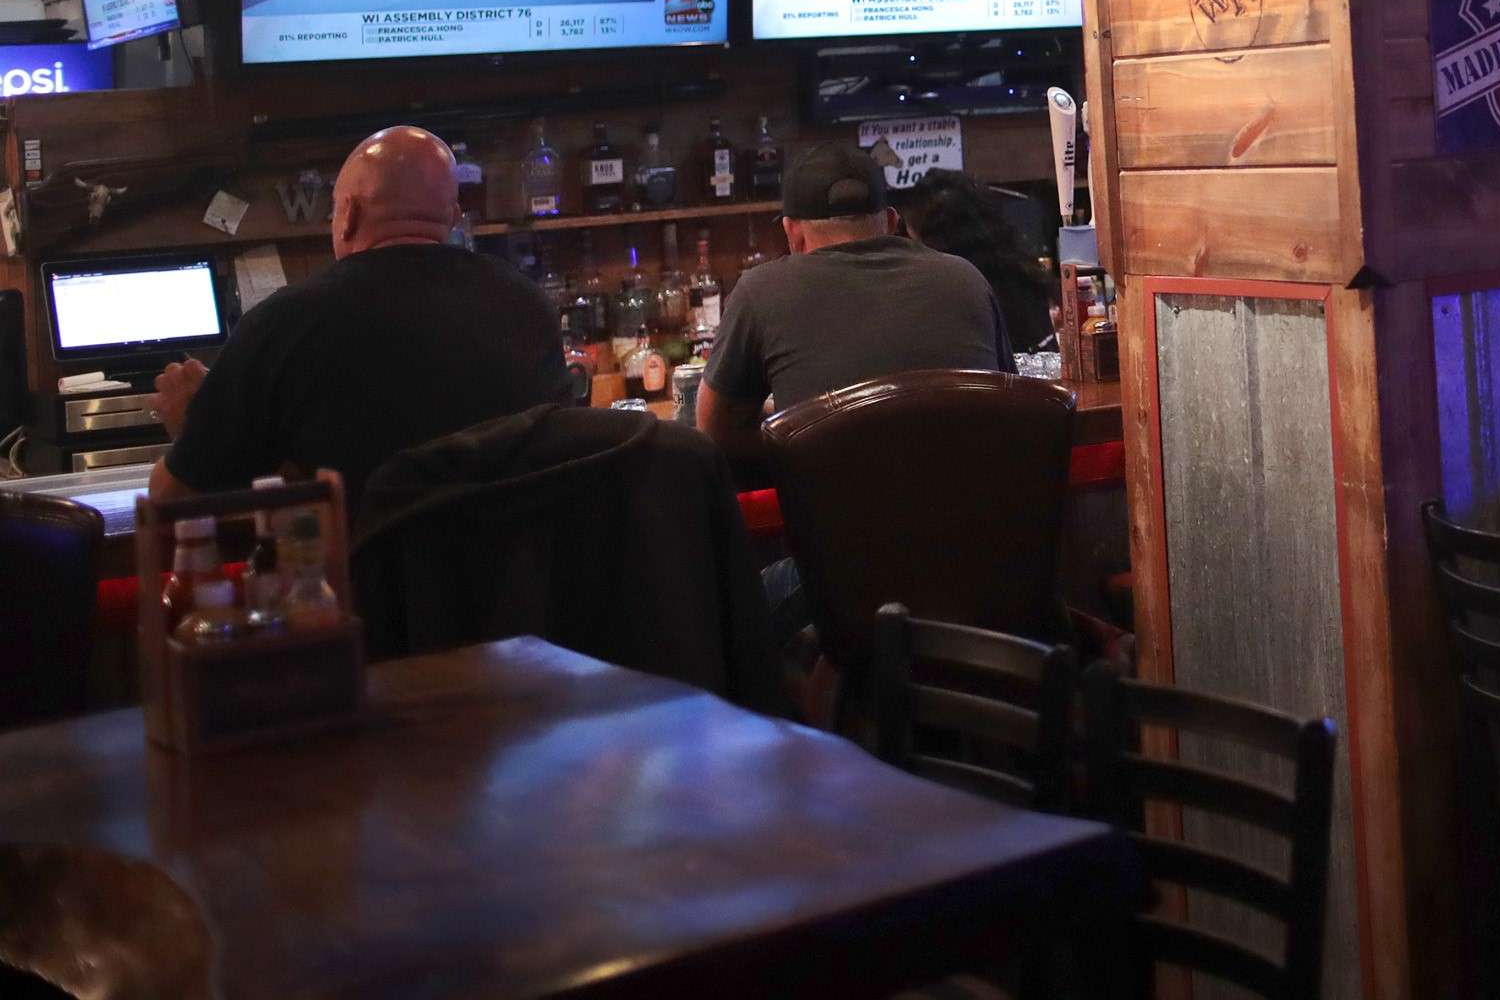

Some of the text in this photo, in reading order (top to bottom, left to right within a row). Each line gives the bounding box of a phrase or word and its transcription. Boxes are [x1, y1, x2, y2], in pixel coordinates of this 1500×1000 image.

[362, 8, 532, 24] WI ASSEMBLY DISTRICT 76
[666, 13, 710, 23] NEWS
[378, 25, 434, 34] FRANCESCA
[297, 32, 348, 41] REPORTING
[378, 35, 419, 43] PATRICK
[908, 153, 928, 166] get
